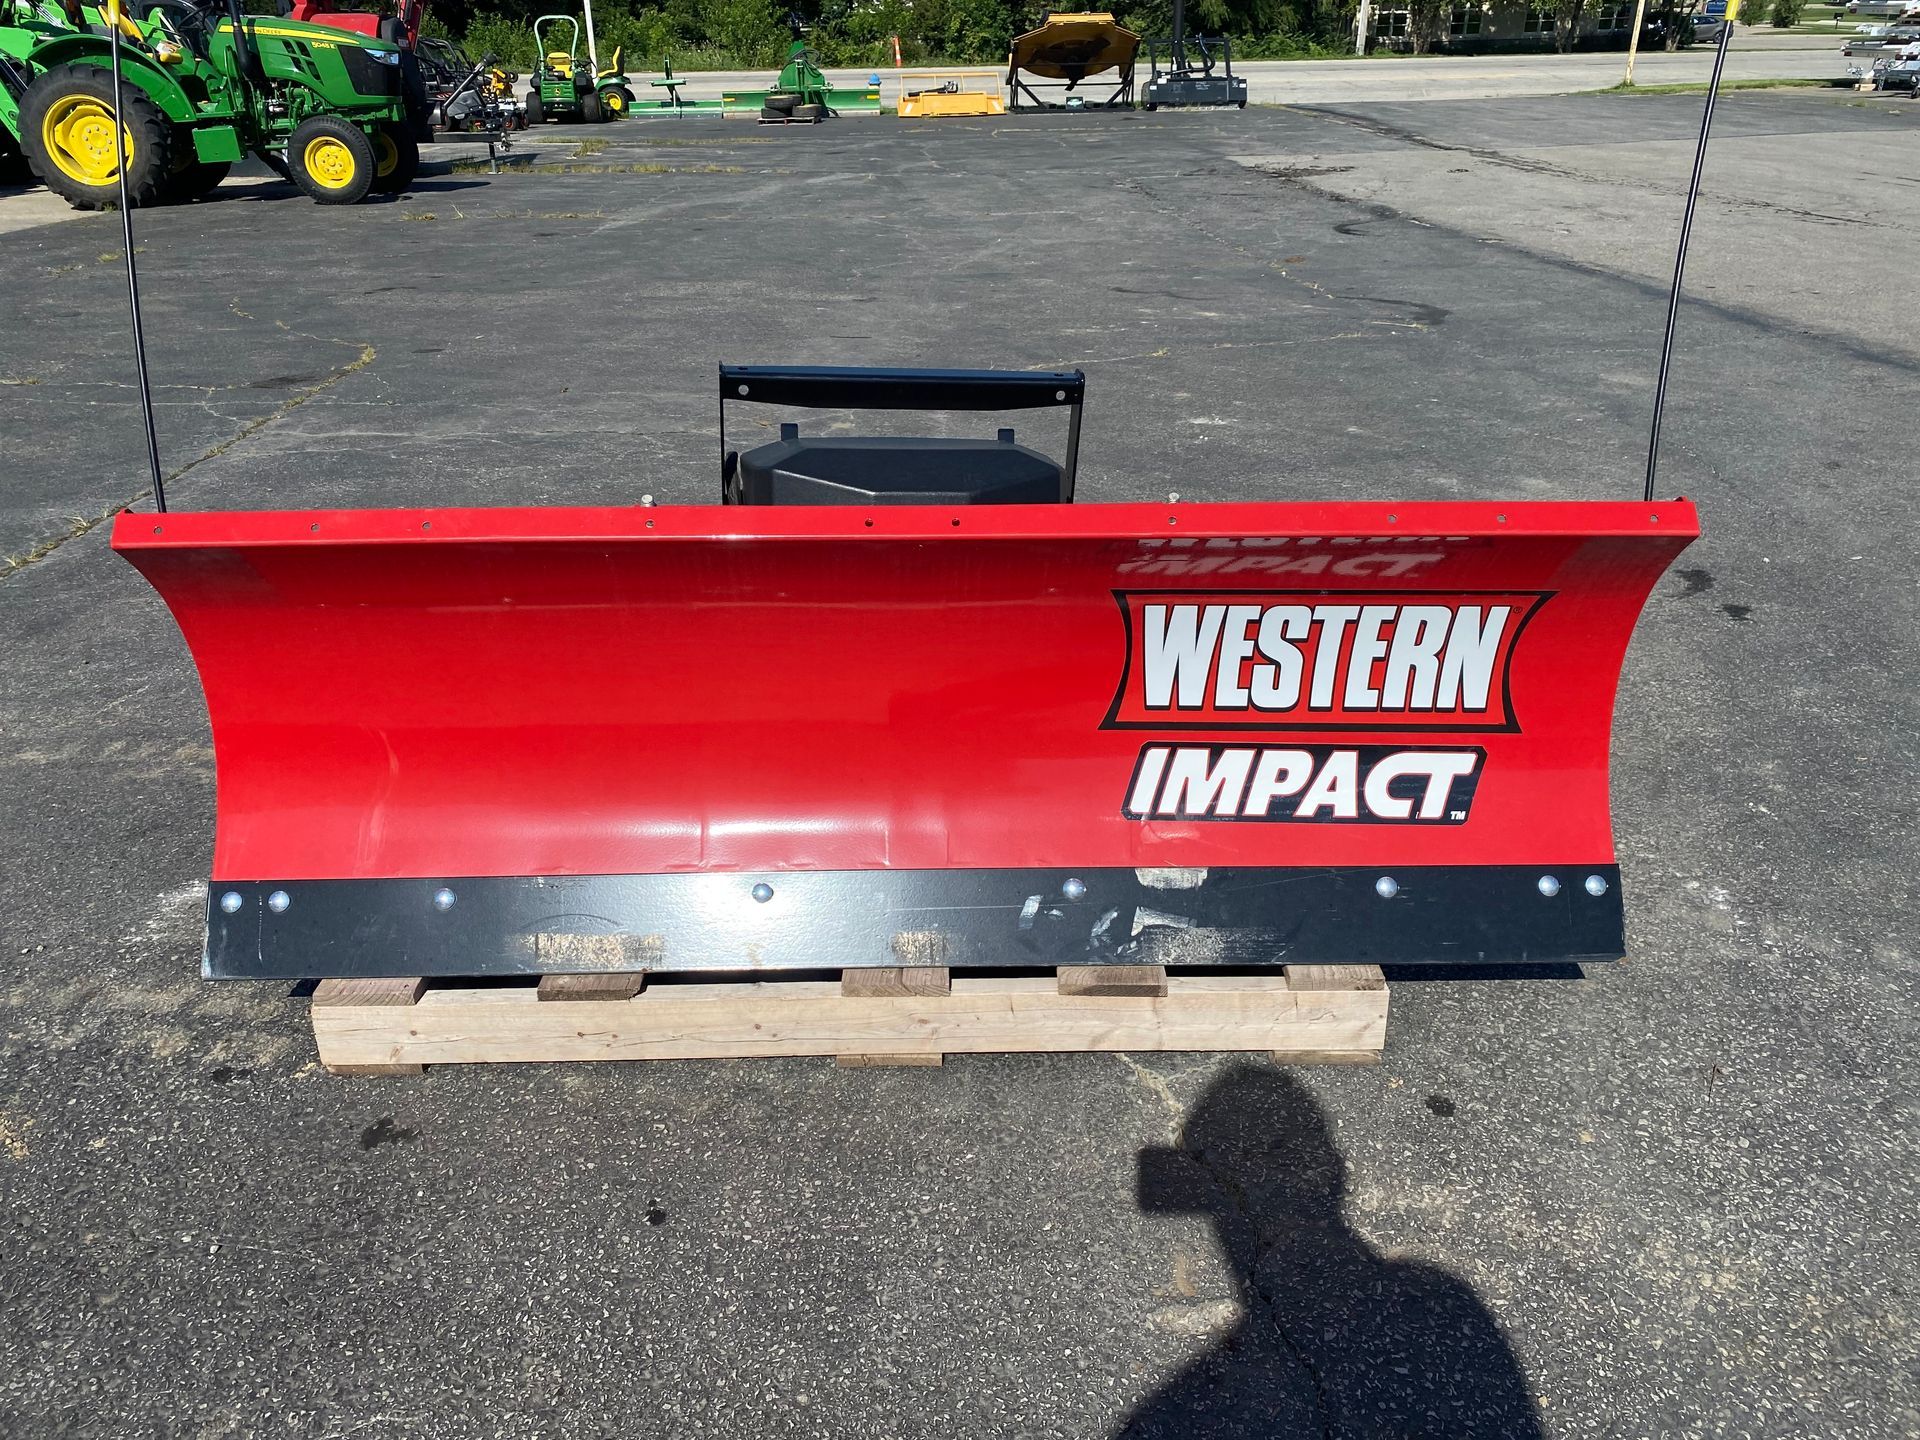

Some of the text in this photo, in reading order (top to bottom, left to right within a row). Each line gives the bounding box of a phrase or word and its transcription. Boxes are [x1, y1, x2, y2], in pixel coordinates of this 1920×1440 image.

[1142, 604, 1511, 712] WESTERN
[1128, 747, 1478, 820] IMPACT TM
